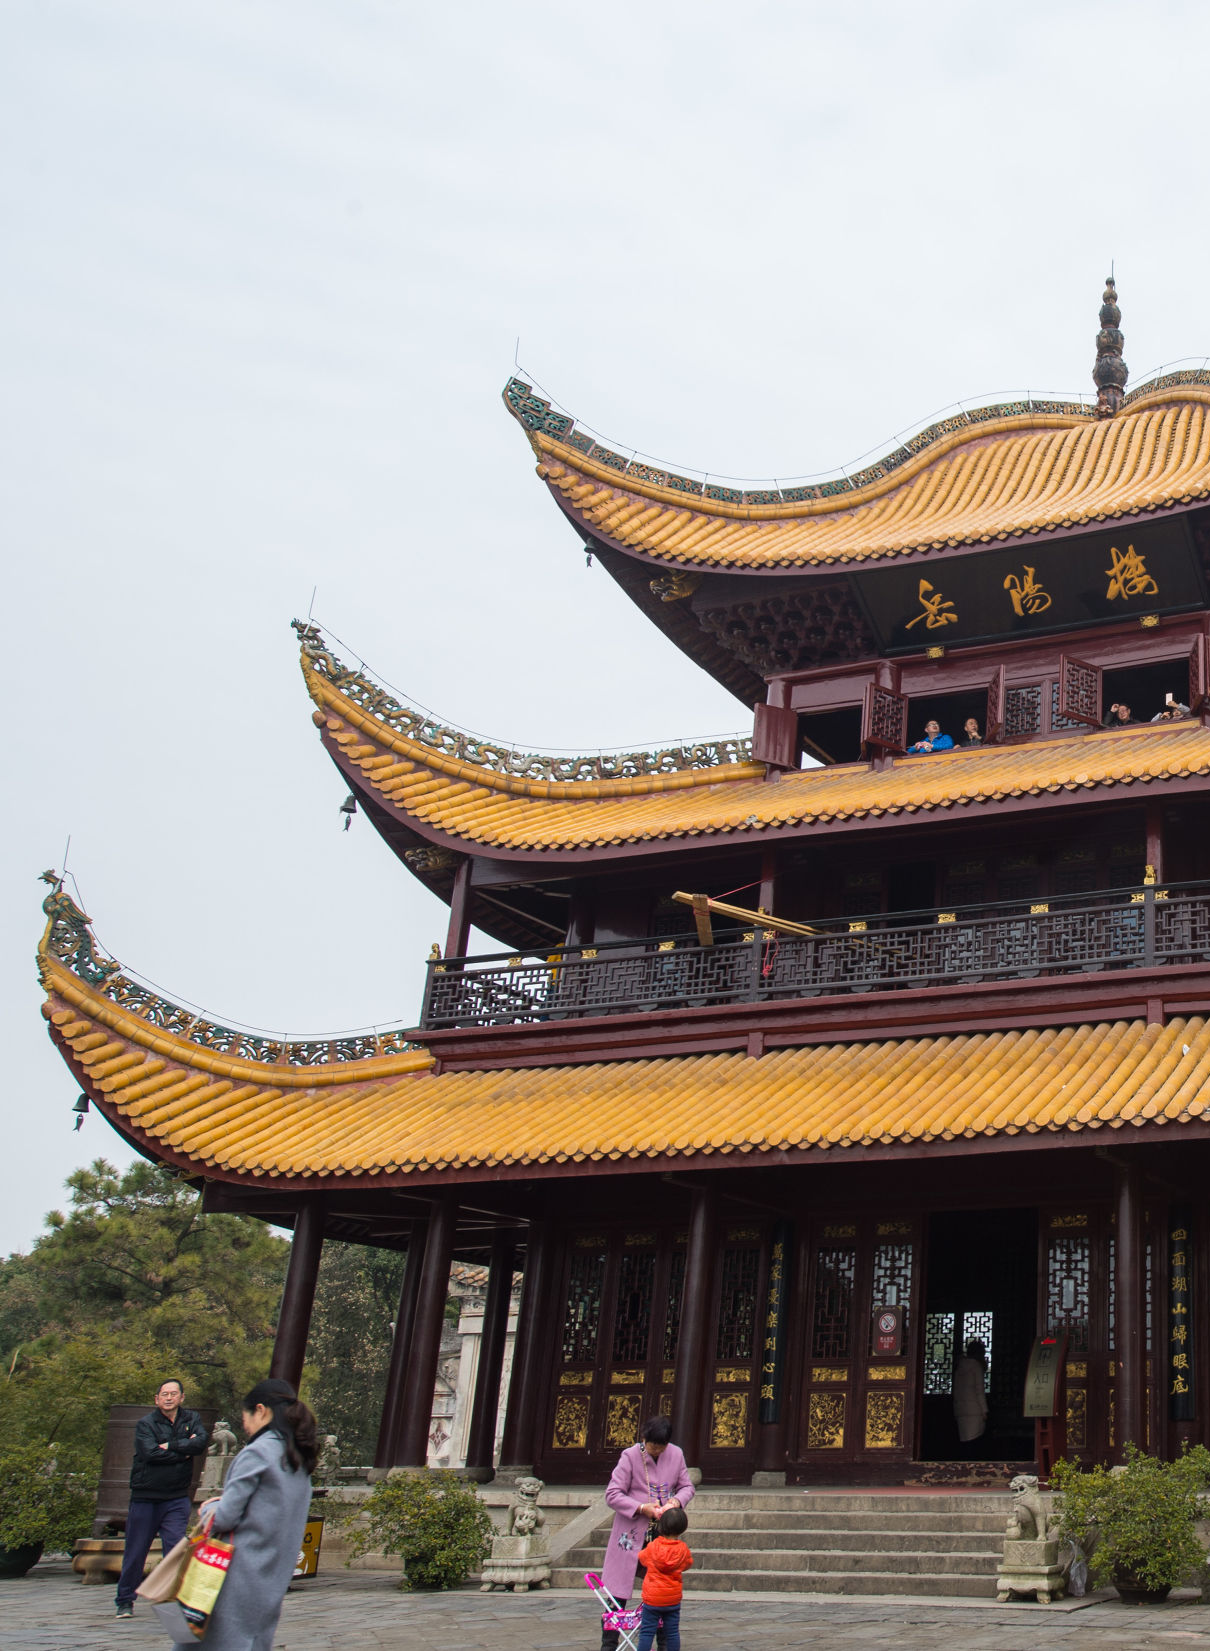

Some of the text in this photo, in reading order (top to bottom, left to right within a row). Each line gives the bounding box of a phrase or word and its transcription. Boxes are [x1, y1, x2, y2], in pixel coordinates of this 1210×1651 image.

[1170, 1229, 1189, 1395] 四面湖山歸眼底
